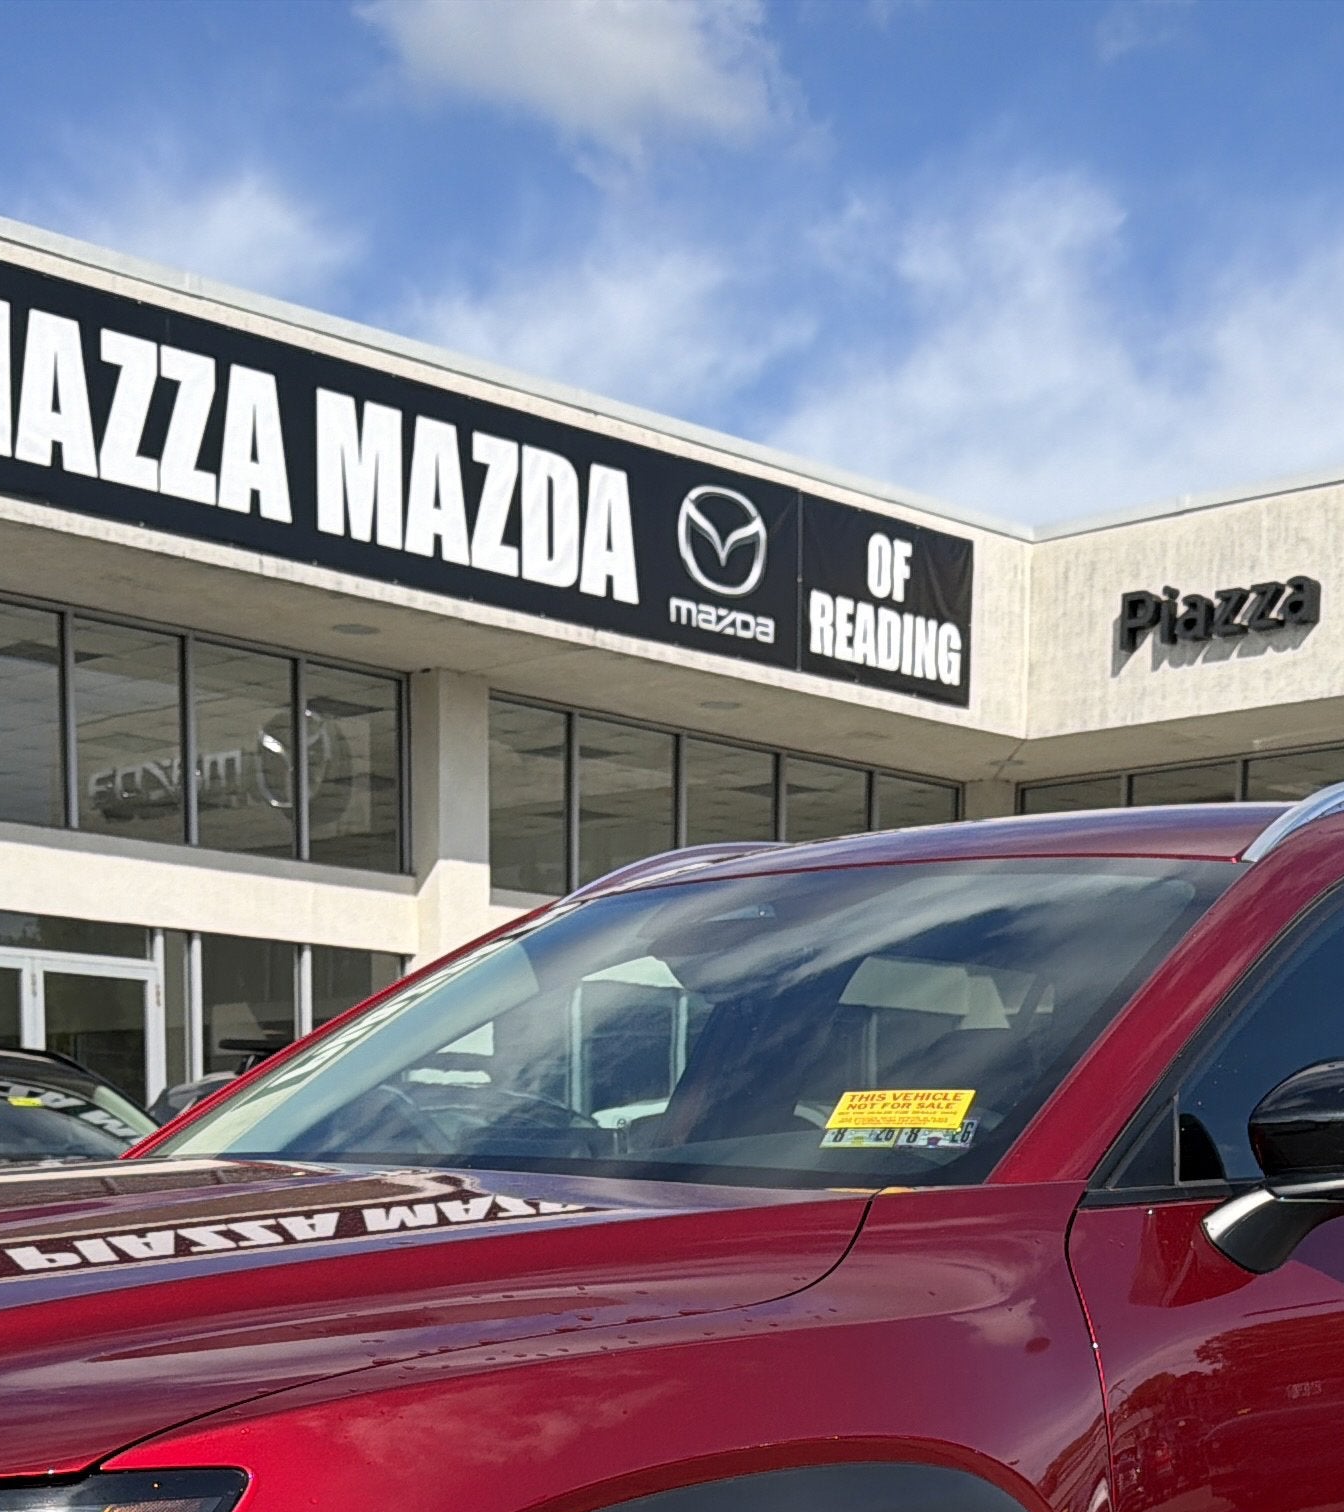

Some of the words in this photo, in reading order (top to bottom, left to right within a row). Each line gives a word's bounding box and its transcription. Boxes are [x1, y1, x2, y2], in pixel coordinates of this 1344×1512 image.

[316, 385, 640, 605] MAZDA
[867, 533, 913, 603] OF
[669, 597, 775, 644] mazda
[809, 589, 962, 686] READING
[1119, 575, 1321, 654] Piazza
[849, 1094, 887, 1102] THIS
[892, 1092, 964, 1102] VEHICLE
[881, 1102, 911, 1110] FOR
[916, 1102, 956, 1110] SALE
